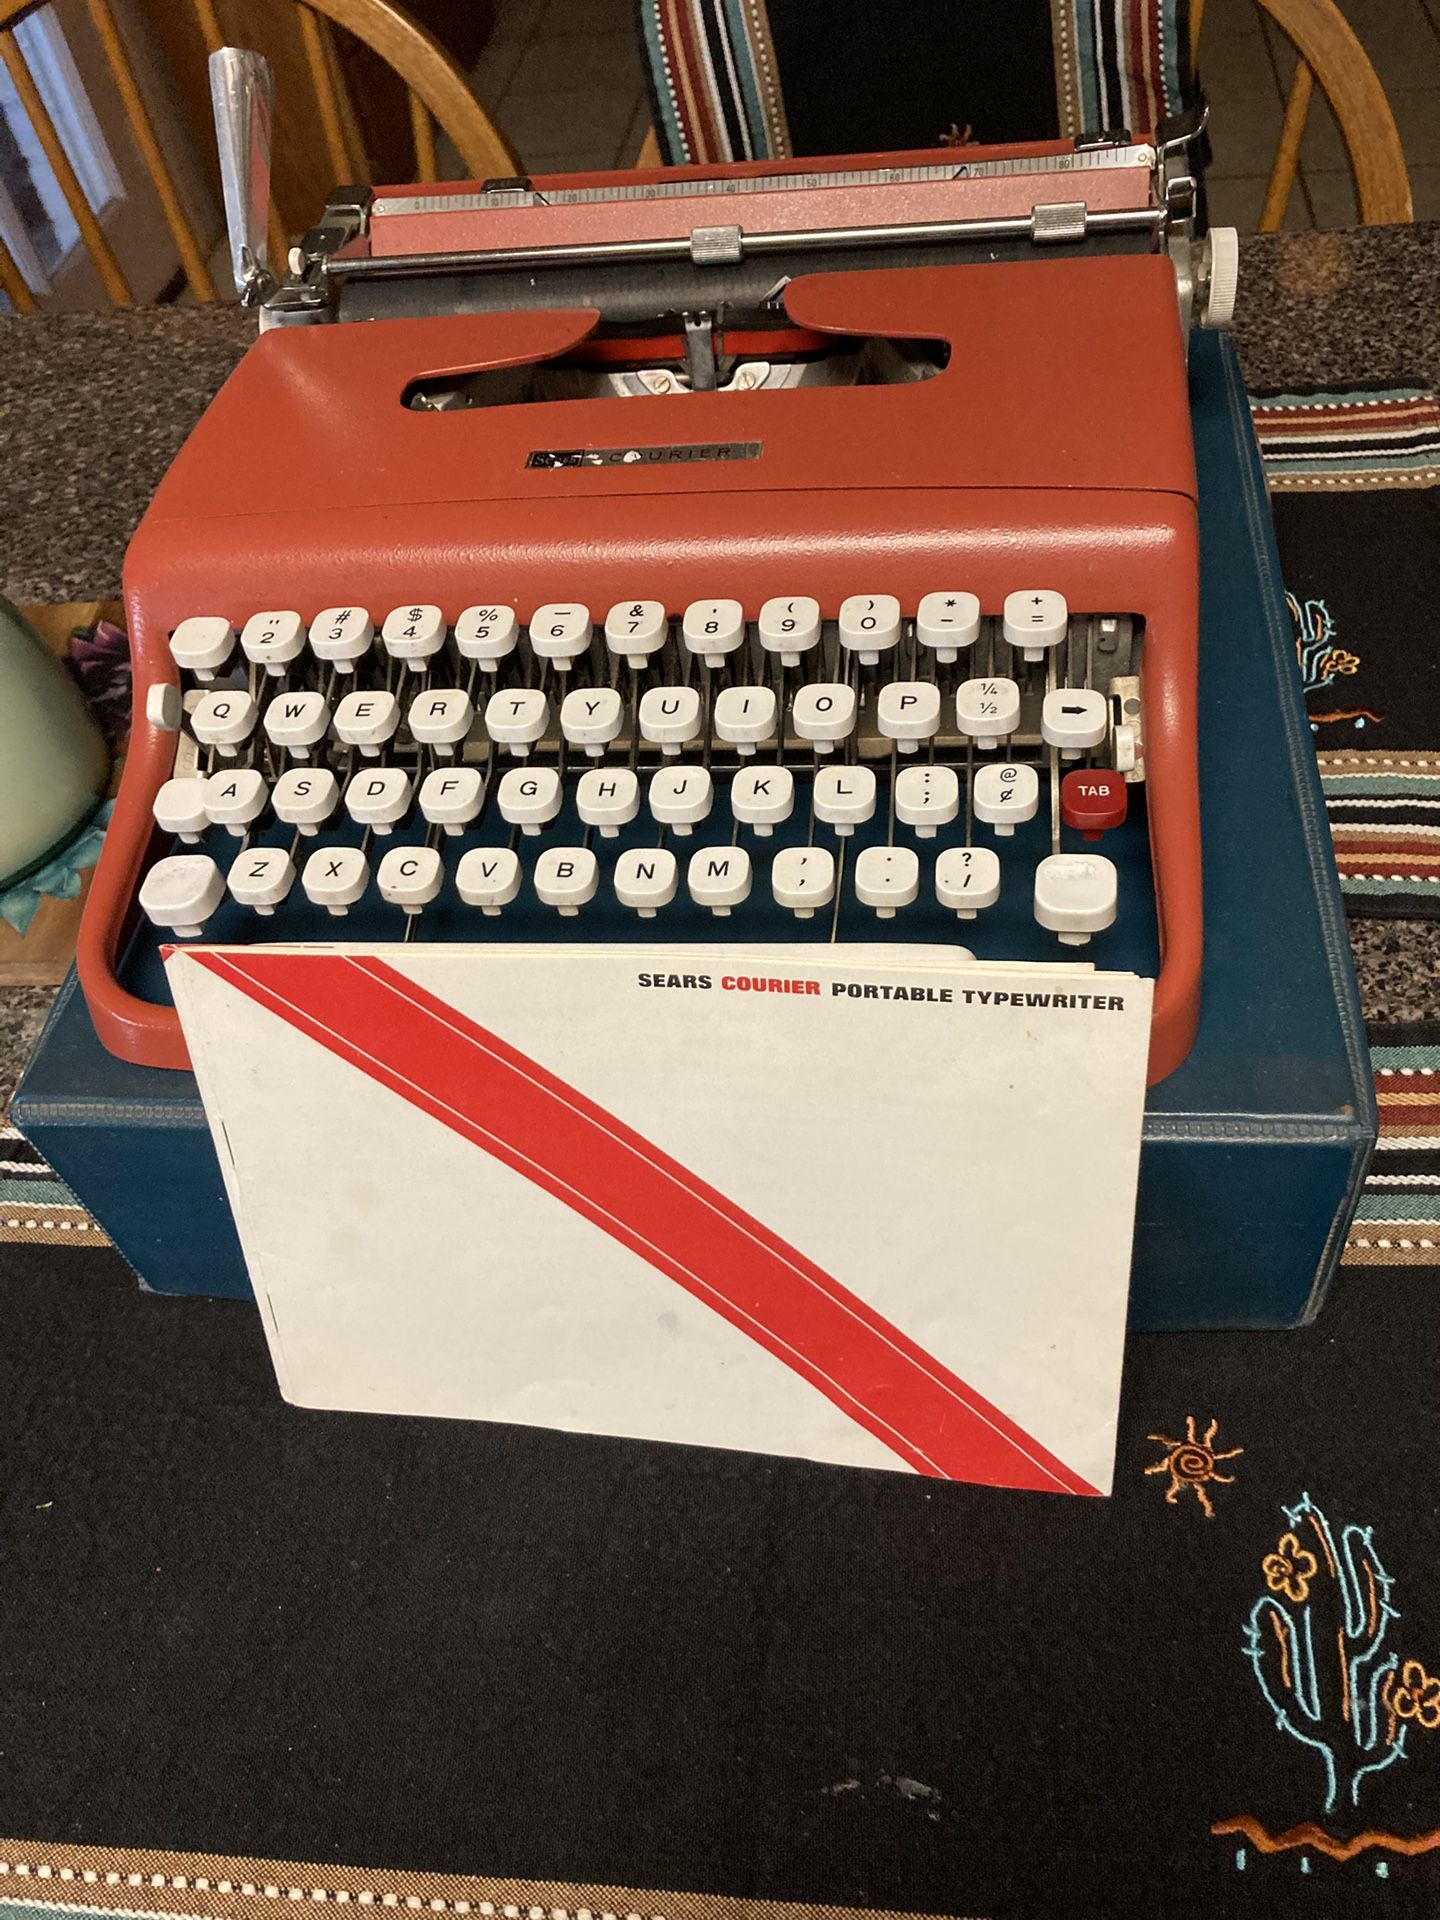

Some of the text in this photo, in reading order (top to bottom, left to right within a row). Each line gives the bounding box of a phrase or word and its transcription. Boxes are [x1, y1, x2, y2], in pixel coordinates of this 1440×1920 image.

[726, 184, 736, 193] 40
[806, 178, 818, 188] 50
[973, 167, 984, 177] 70
[1058, 159, 1070, 169] 80
[407, 608, 423, 622] $
[478, 608, 498, 622] %
[629, 604, 645, 617] &
[336, 610, 351, 625] #
[403, 626, 416, 637] 4
[551, 625, 564, 636] 6
[628, 622, 639, 633] 7
[705, 622, 718, 633] 8
[782, 619, 795, 631] 9
[260, 632, 274, 643] 2
[328, 627, 342, 640] 3
[476, 627, 489, 638] 5
[430, 702, 446, 715] R
[511, 702, 525, 715] T
[586, 702, 600, 715] Y
[662, 700, 679, 714] U
[743, 700, 749, 713] I
[816, 697, 832, 711] O
[901, 696, 917, 709] P
[213, 704, 230, 718] Q
[286, 704, 305, 717] W
[356, 704, 374, 716] E
[1000, 768, 1017, 782] @
[221, 784, 236, 797] A
[294, 782, 311, 795] S
[367, 782, 385, 795] D
[441, 781, 458, 795] F
[520, 781, 537, 795] G
[599, 783, 616, 796] H
[674, 780, 686, 794] J
[754, 780, 770, 794] K
[837, 780, 852, 794] L
[1078, 786, 1109, 795] TAB
[962, 853, 971, 866] ?
[249, 862, 269, 877] Z
[325, 862, 342, 876] X
[400, 861, 418, 876] C
[482, 863, 497, 877] V
[557, 863, 574, 877] B
[637, 864, 654, 879] N
[708, 861, 728, 876] M
[638, 973, 1125, 1011] SEARS COURIER PORTABLE TYPEWRITER
